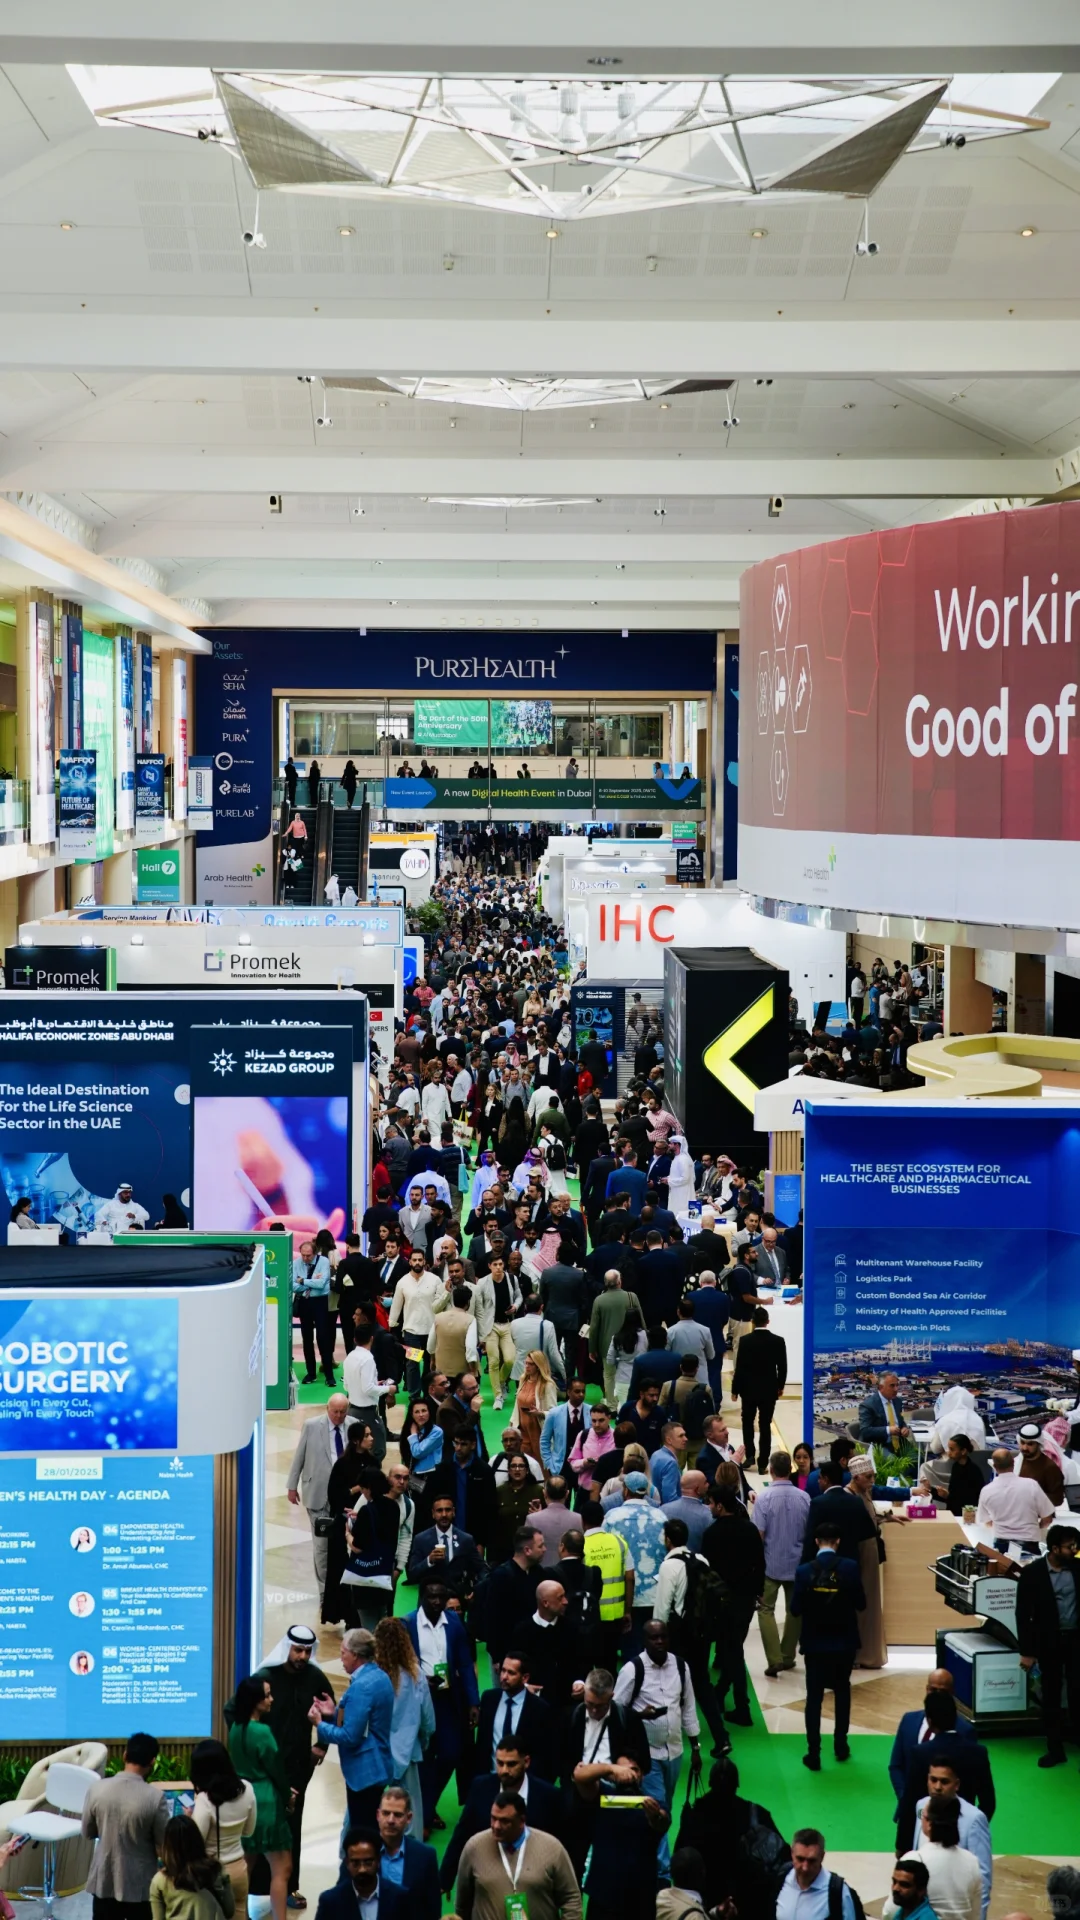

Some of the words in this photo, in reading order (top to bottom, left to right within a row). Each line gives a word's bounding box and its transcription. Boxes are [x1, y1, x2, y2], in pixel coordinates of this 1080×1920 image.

[214, 641, 230, 650] Our
[214, 652, 244, 660] Assets:
[222, 682, 246, 690] SEHA
[905, 687, 1009, 758] Good
[1024, 683, 1078, 756] of
[222, 732, 248, 742] PURA
[501, 789, 529, 797] Health
[531, 789, 555, 797] Event
[567, 789, 592, 797] Dubai
[142, 864, 160, 872] Hall
[165, 863, 172, 872] 7
[600, 904, 675, 942] IHC
[230, 952, 301, 969] Promek
[36, 970, 100, 984] Promek
[35, 1032, 86, 1040] ECONOMIC
[88, 1032, 119, 1040] ZONES
[121, 1032, 142, 1040] ABU
[143, 1032, 174, 1040] DHABI
[245, 1063, 286, 1073] KEZAD
[289, 1063, 335, 1074] GROUP
[0, 1084, 24, 1095] The
[27, 1084, 62, 1095] Ideal
[65, 1084, 149, 1095] Destination
[0, 1101, 19, 1112] for
[23, 1101, 46, 1112] the
[49, 1101, 76, 1112] Life
[79, 1101, 133, 1112] Science
[0, 1118, 45, 1128] Sector
[48, 1118, 61, 1128] in
[64, 1118, 88, 1128] the
[91, 1118, 121, 1128] UAE
[850, 1164, 873, 1172] THE
[876, 1164, 904, 1173] BEST
[907, 1164, 974, 1173] ECOSYSTEM
[977, 1165, 1001, 1173] FOR
[820, 1174, 896, 1183] HEALTHCARE
[898, 1175, 923, 1183] AND
[926, 1175, 1031, 1184] PHARMACEUTICAL
[891, 1185, 960, 1194] BUSINESSES
[953, 1259, 983, 1269] Facility
[856, 1275, 892, 1284] Logistics
[856, 1308, 888, 1317] Ministry
[929, 1308, 968, 1317] Approved
[856, 1324, 928, 1333] Ready-to-move-in
[0, 1342, 128, 1364] OBOTIC
[0, 1370, 130, 1394] URGERY
[0, 1399, 28, 1408] cision
[31, 1399, 40, 1407] in
[43, 1399, 69, 1409] Every
[71, 1399, 92, 1408] Cut,
[24, 1409, 33, 1418] in
[36, 1409, 62, 1419] Every
[65, 1409, 94, 1417] Touch
[44, 1468, 98, 1476] 28/01/2025
[29, 1491, 77, 1501] HEALTH
[81, 1490, 106, 1500] DAY
[117, 1490, 170, 1500] AGENDA
